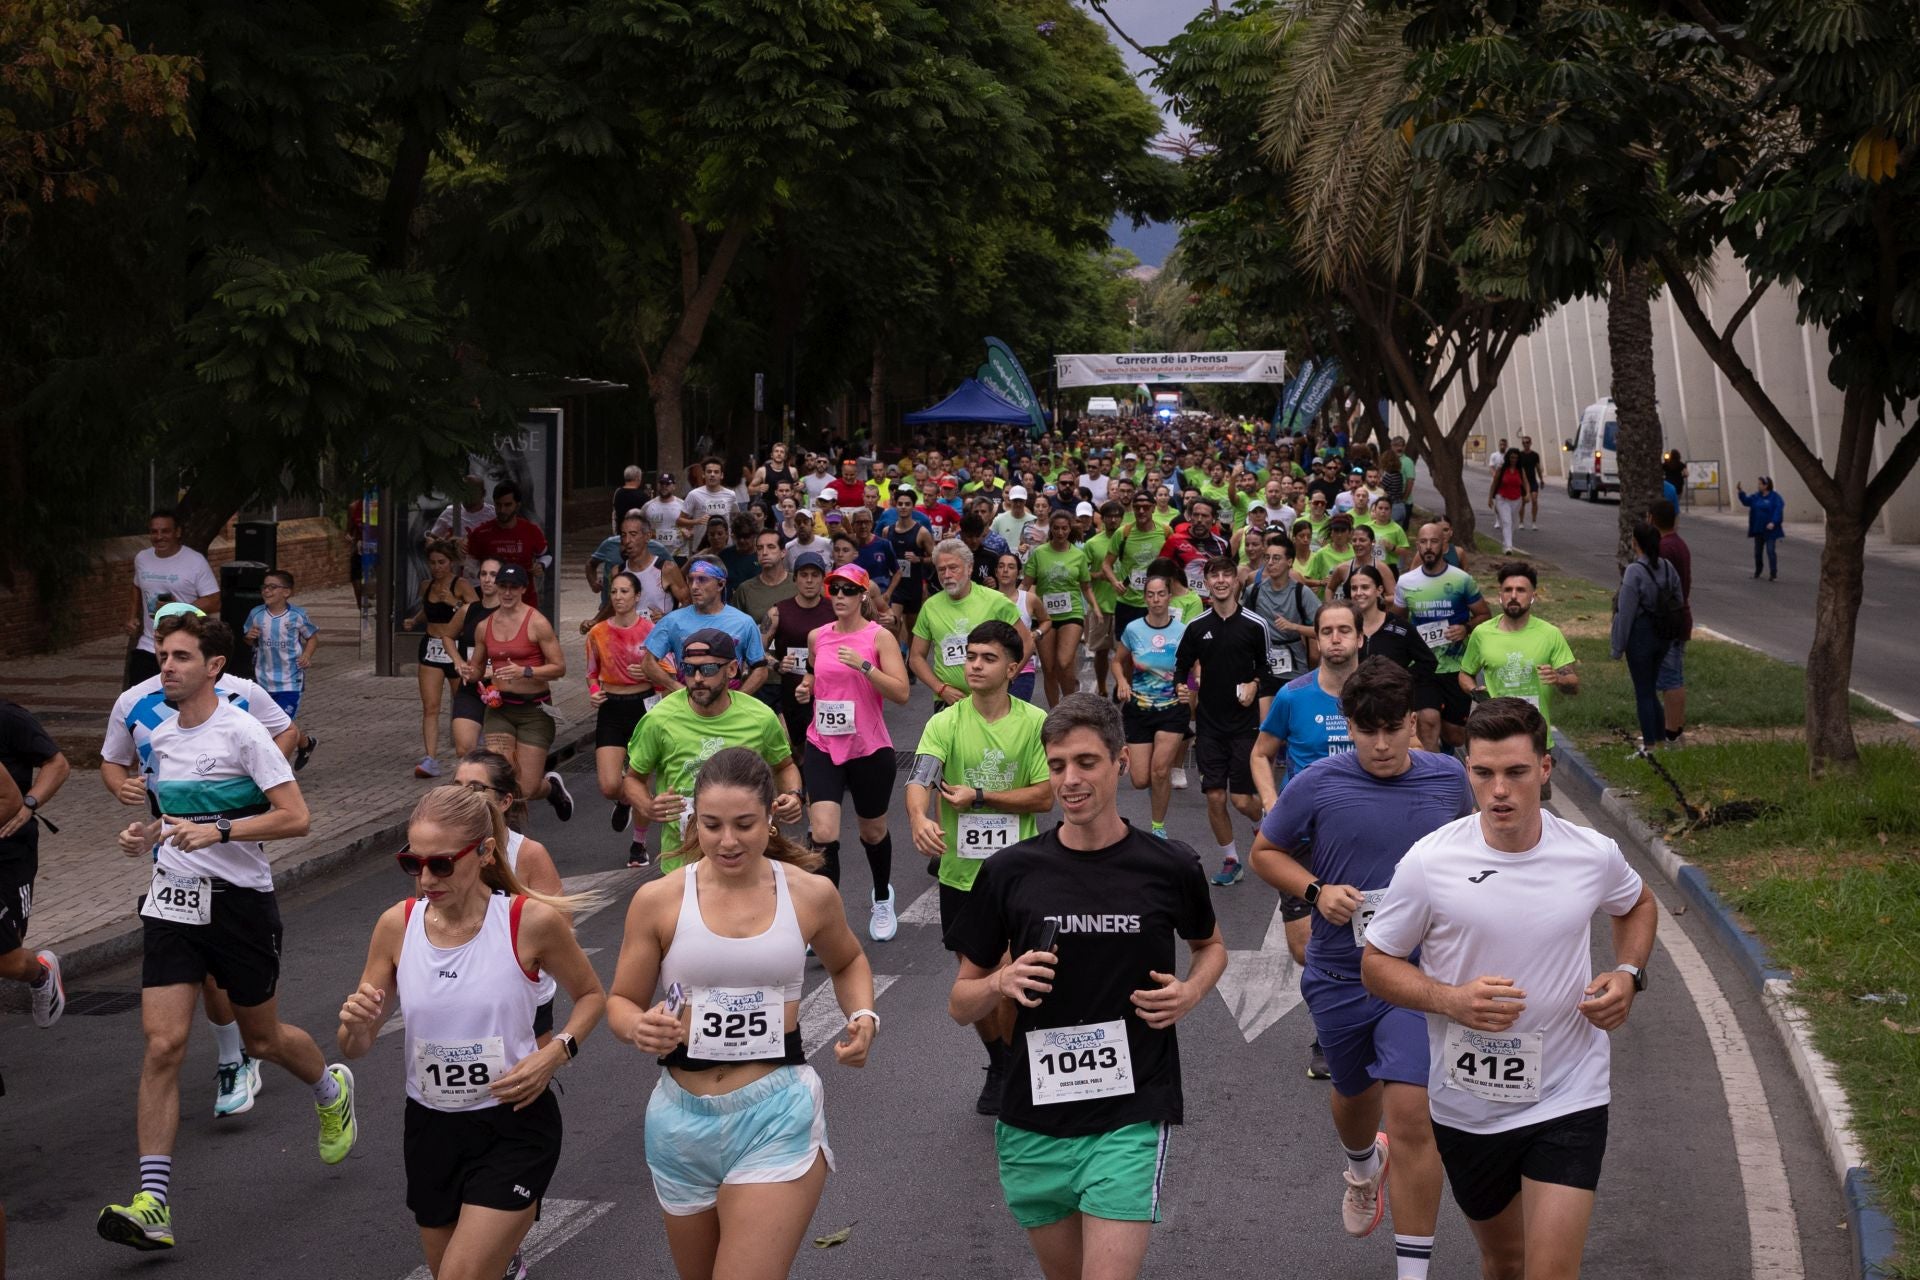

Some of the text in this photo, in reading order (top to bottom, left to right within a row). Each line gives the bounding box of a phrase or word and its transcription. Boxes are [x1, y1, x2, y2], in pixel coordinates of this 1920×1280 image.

[1116, 354, 1228, 365] Carrera de la Prensa
[1046, 600, 1067, 608] 803
[1422, 629, 1443, 641] 787
[819, 712, 846, 725] 793
[966, 830, 1007, 845] 811
[157, 887, 201, 909] 483
[702, 1011, 767, 1038] 325
[1040, 1047, 1117, 1075] 1043
[1456, 1052, 1525, 1081] 412
[426, 1063, 490, 1087] 128
[513, 1184, 531, 1198] FILA
